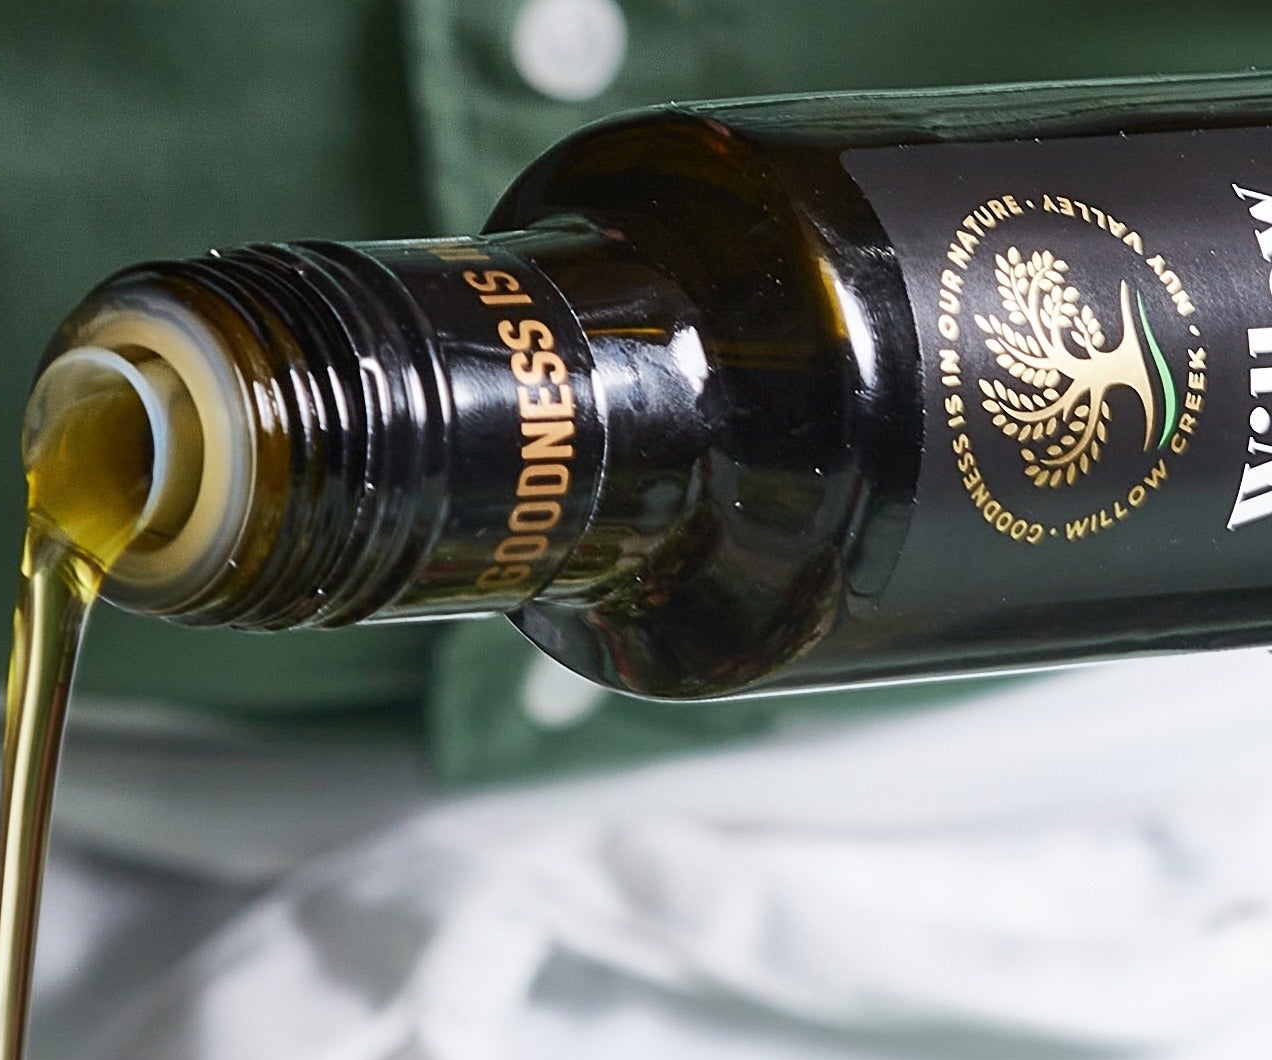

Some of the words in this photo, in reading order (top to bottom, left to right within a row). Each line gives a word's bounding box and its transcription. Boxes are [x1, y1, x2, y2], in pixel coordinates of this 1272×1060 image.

[947, 195, 1024, 270] NATURE
[1043, 194, 1143, 255] VALLEY
[463, 270, 534, 306] IS
[938, 269, 965, 342] OUR
[1145, 254, 1196, 317] NUY
[939, 349, 961, 387] IN
[944, 394, 966, 428] IS
[1065, 458, 1169, 541] WILLOW
[1170, 346, 1207, 455] CREEK
[477, 319, 575, 589] GOODNESS
[952, 433, 1044, 543] GOODNESS
